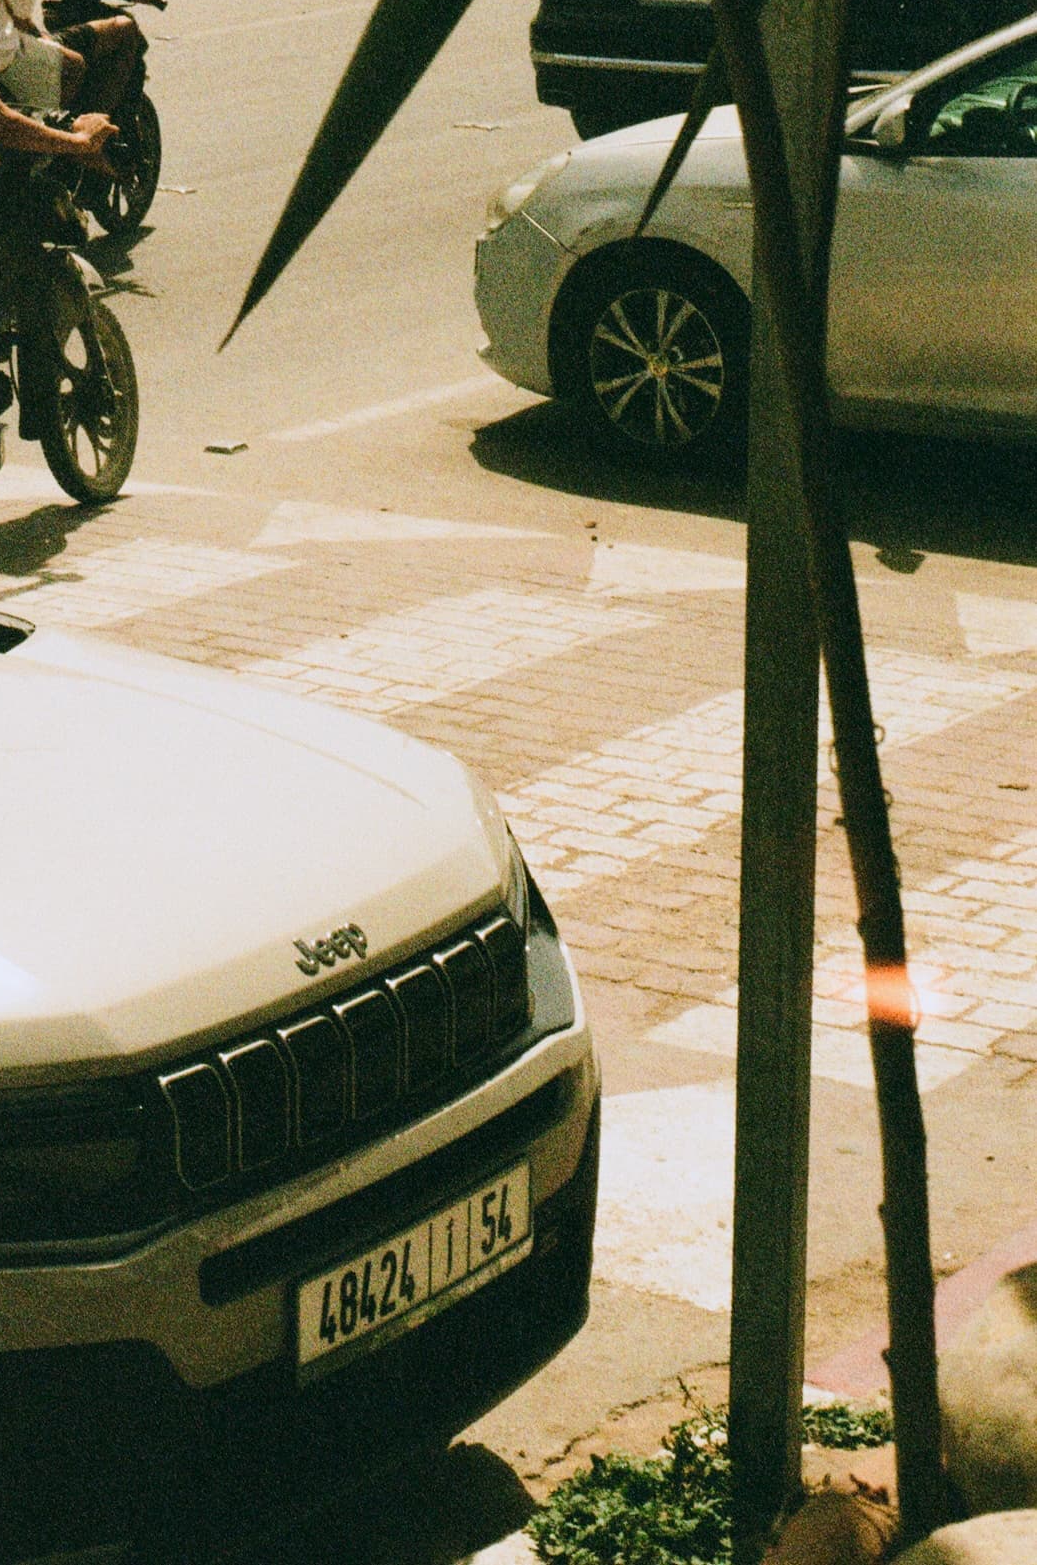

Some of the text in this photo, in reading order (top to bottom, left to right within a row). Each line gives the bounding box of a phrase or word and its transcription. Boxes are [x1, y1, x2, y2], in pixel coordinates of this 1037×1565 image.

[292, 923, 368, 977] Jeep
[319, 1239, 415, 1344] 48424
[482, 1184, 512, 1255] 54
